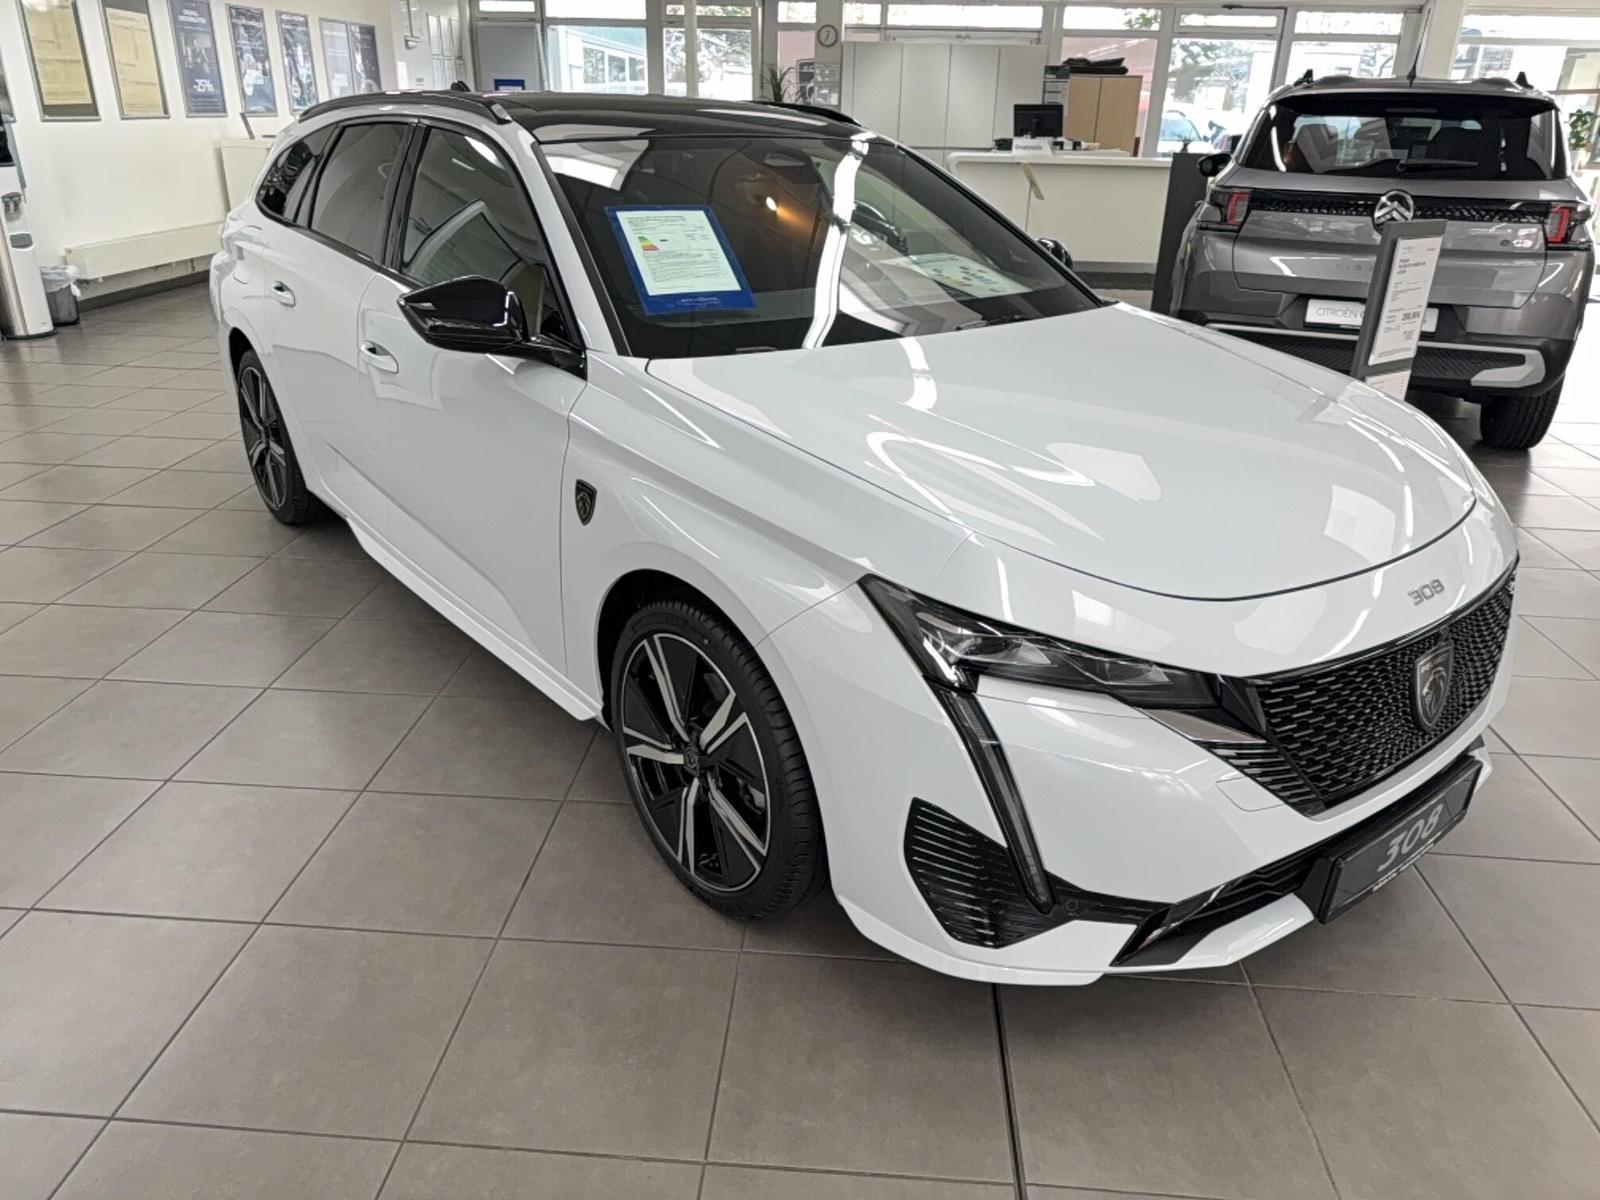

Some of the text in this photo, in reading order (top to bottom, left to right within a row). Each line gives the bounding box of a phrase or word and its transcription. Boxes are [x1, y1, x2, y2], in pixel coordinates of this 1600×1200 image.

[1315, 307, 1357, 319] CITROËN
[1407, 579, 1445, 606] 308
[1376, 803, 1444, 873] 308
